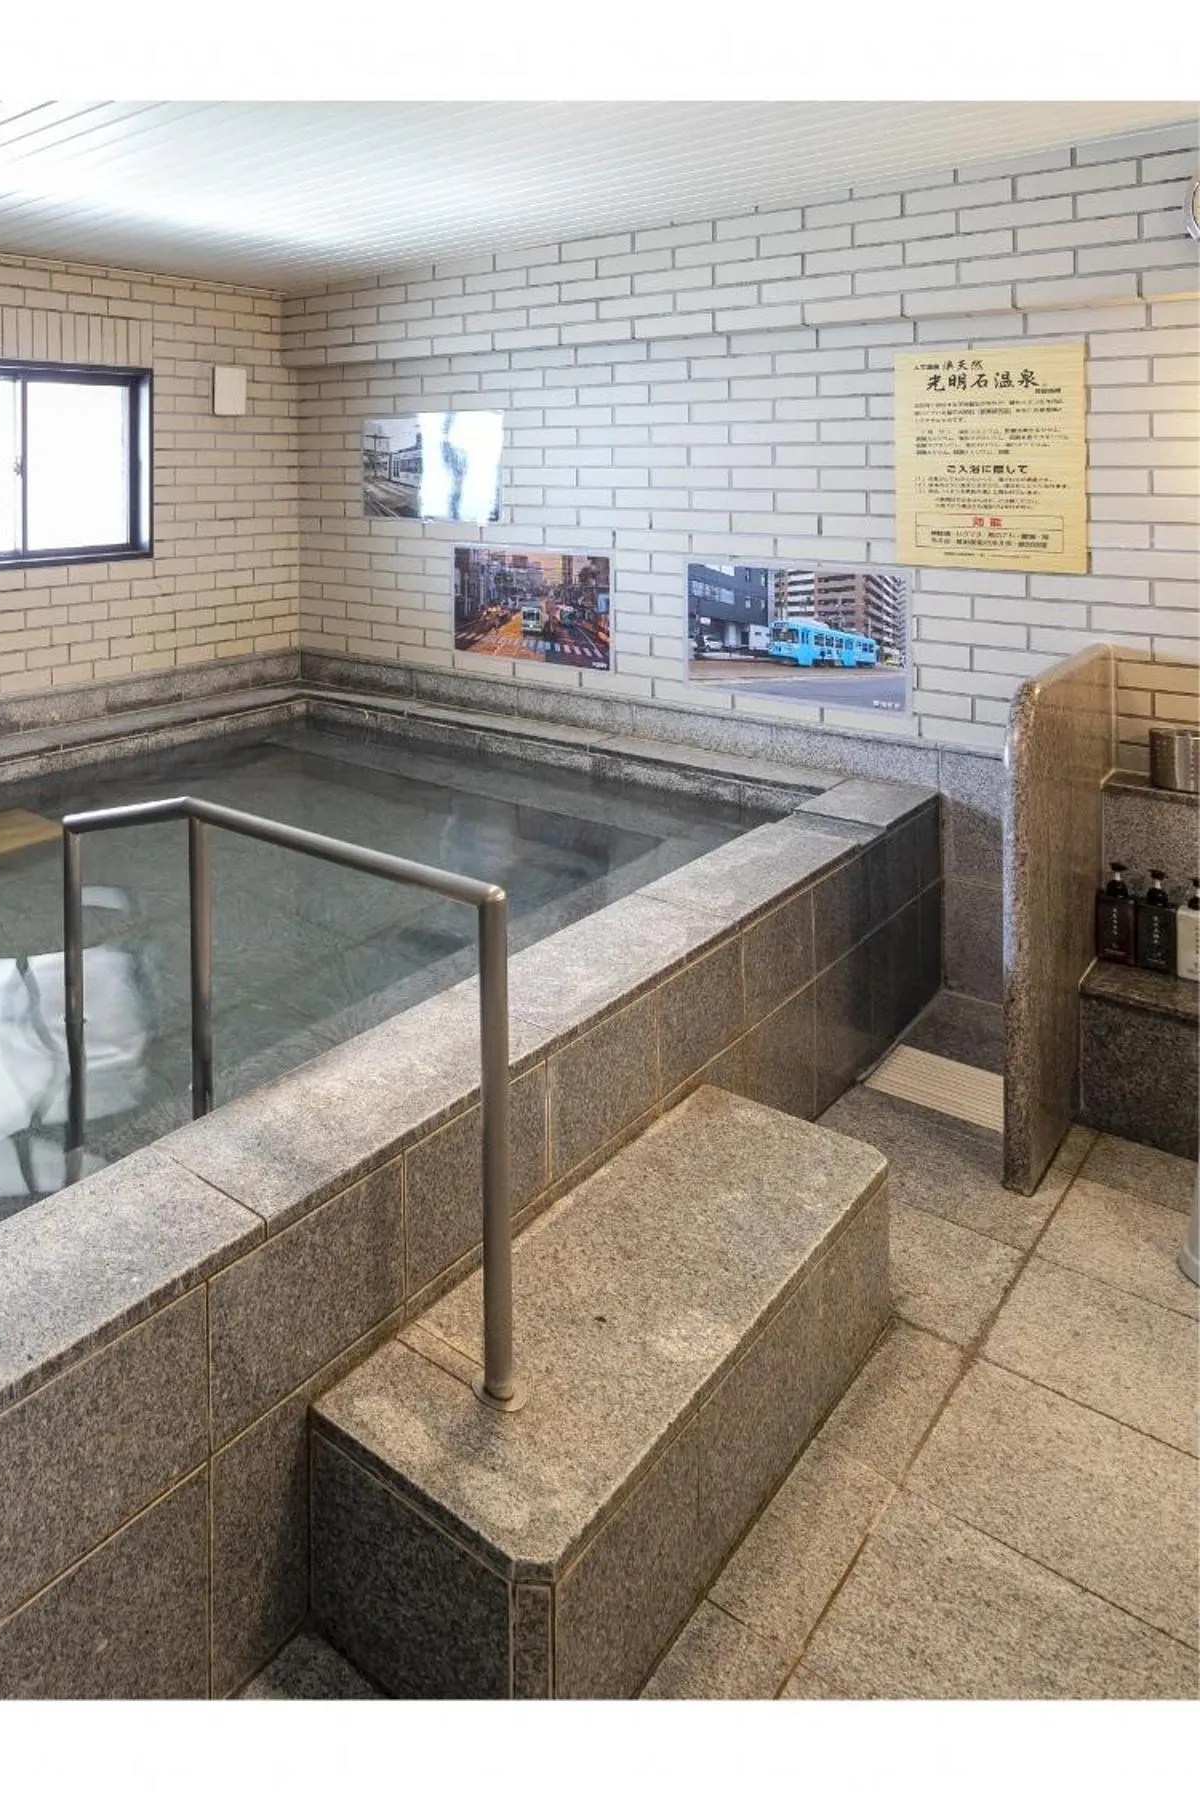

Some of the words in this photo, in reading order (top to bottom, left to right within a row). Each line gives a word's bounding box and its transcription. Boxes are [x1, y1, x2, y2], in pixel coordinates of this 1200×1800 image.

[926, 368, 1040, 392] 光明石温泉
[946, 464, 1028, 474] ご入浴に際して
